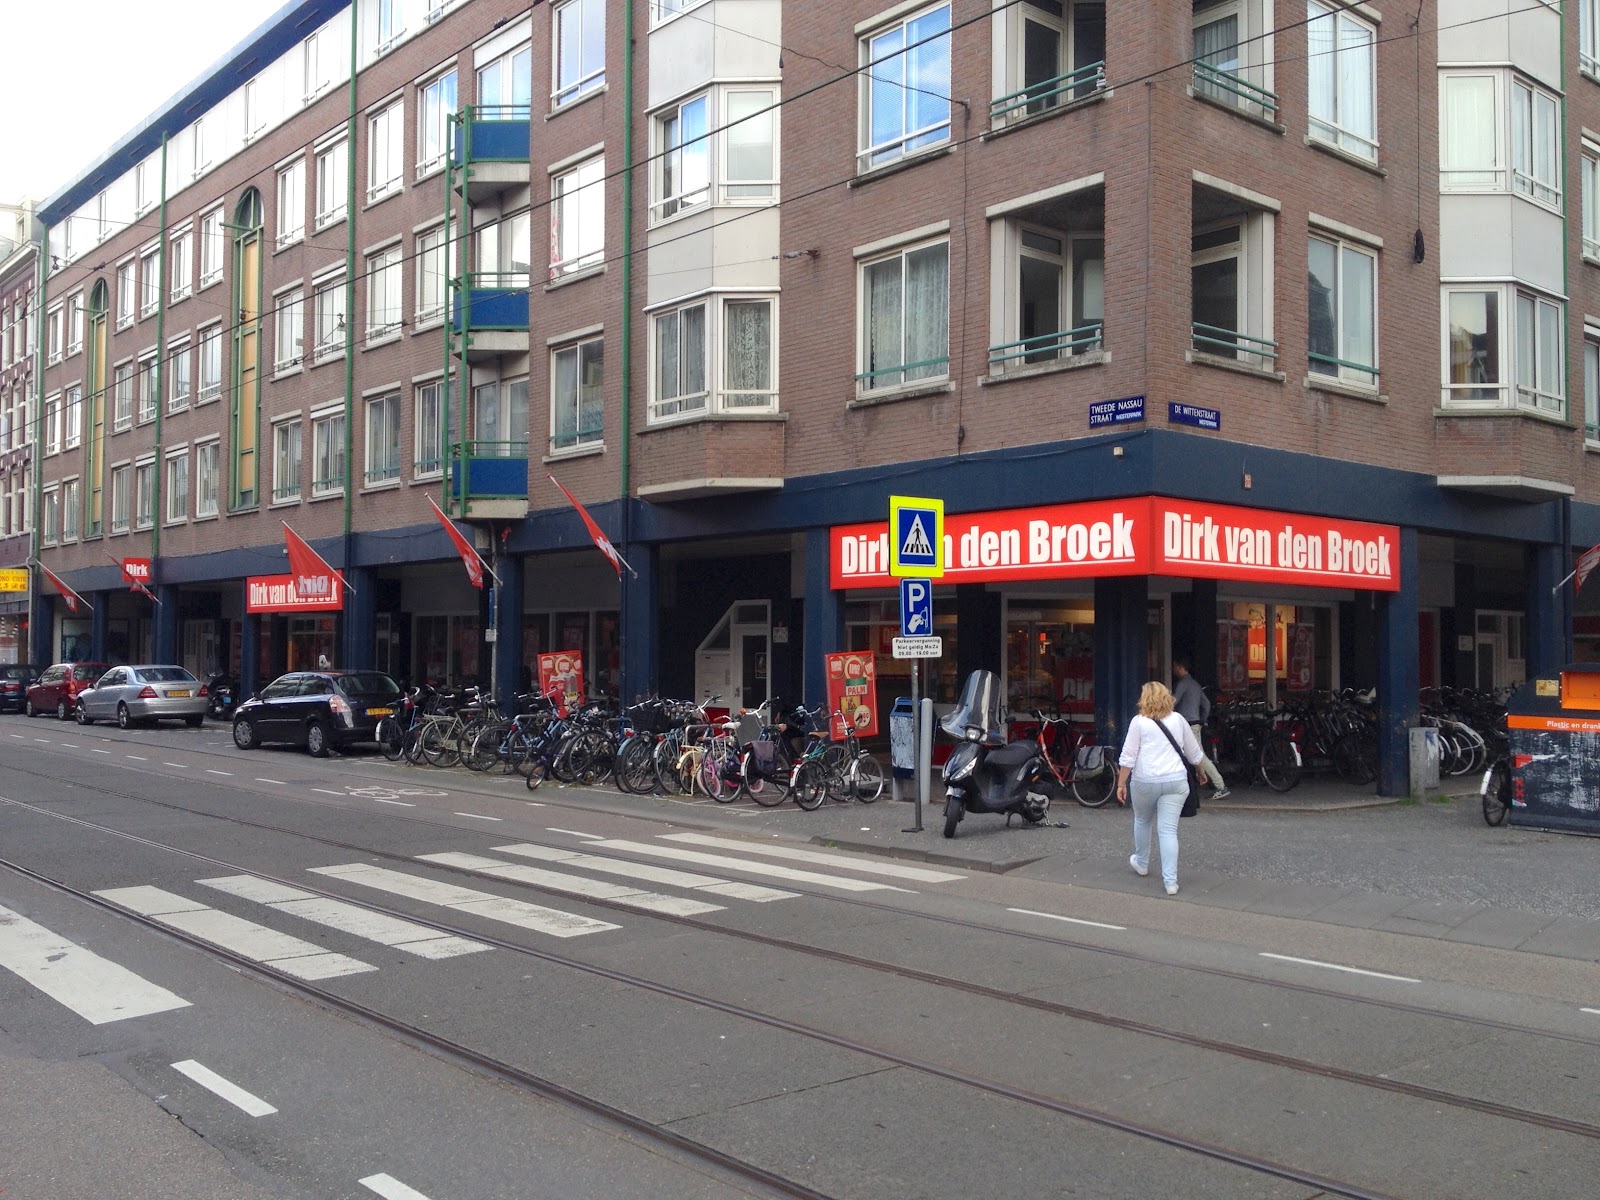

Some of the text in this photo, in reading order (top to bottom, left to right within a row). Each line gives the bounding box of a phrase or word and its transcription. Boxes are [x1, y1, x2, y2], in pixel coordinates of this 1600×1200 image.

[1091, 398, 1143, 415] TWEEDE NASSAU
[1175, 404, 1216, 420] DE WITTENSTRAAT
[1090, 413, 1113, 424] STRAAT
[960, 525, 1020, 568] den
[1029, 512, 1135, 563] Broek
[1164, 512, 1391, 576] Dirk van den Broek
[126, 563, 148, 576] Dirk
[250, 582, 268, 605] Dirk
[269, 584, 286, 604] van
[908, 583, 925, 612] P
[848, 686, 866, 694] PALM
